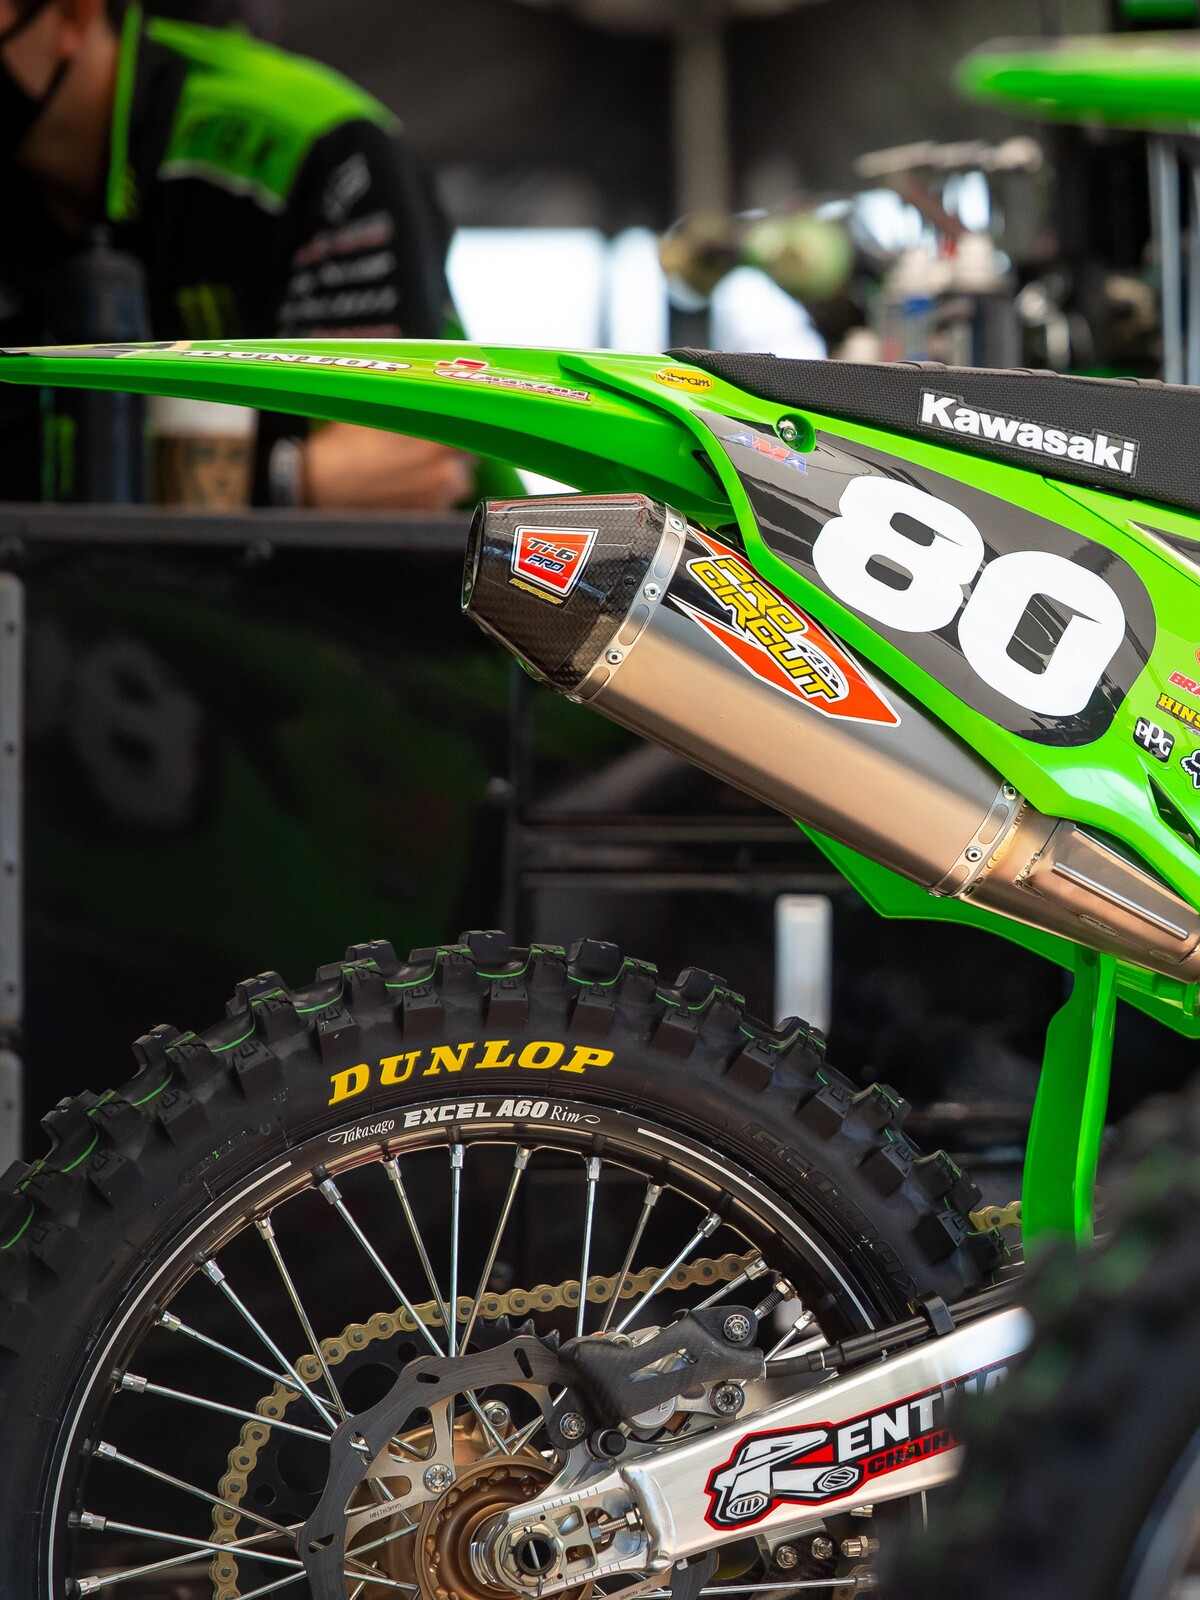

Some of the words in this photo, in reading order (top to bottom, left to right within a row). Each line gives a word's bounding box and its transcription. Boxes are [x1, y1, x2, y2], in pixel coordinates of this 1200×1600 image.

[655, 372, 711, 389] vibram
[722, 430, 808, 476] AMA
[921, 392, 1136, 474] Kawasaki
[525, 553, 566, 573] PRO
[526, 537, 578, 562] Ti-6
[714, 557, 805, 633] PRO
[812, 475, 1126, 717] 80
[689, 561, 839, 699] CIRCUIT
[328, 1040, 615, 1106] DUNLOP
[328, 1119, 395, 1146] Takasago
[404, 1102, 491, 1128] EXCEL
[495, 1099, 549, 1118] A60
[549, 1106, 600, 1125] Rim
